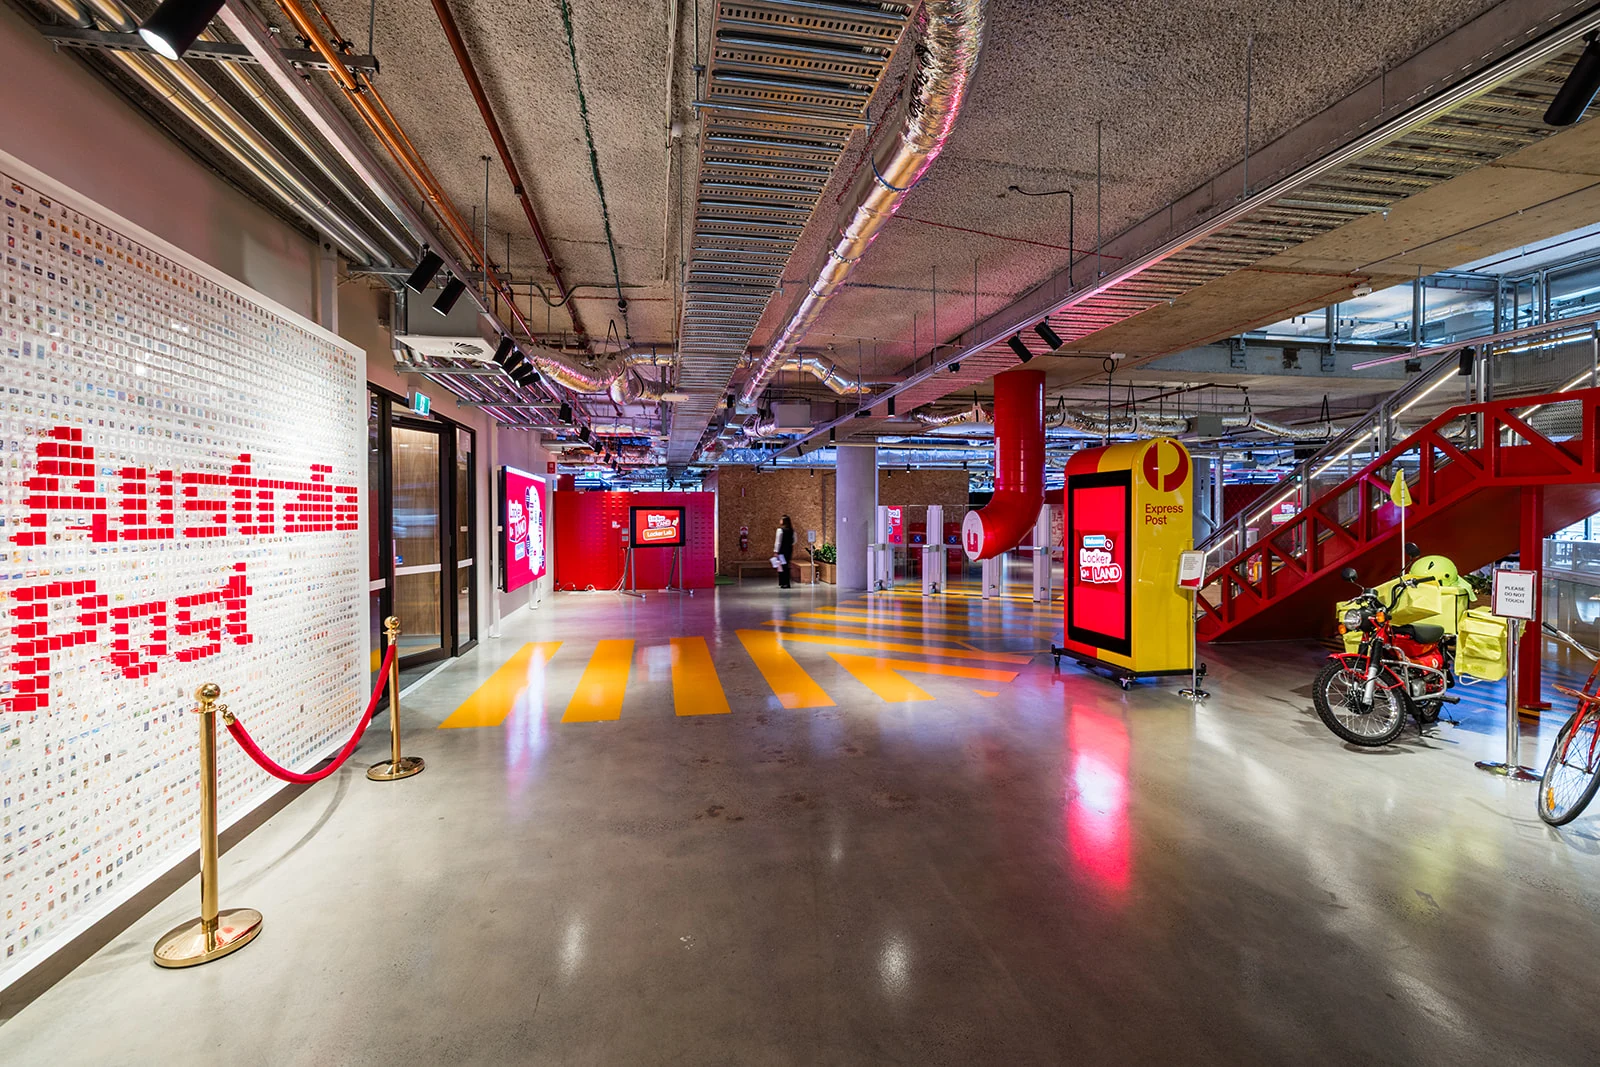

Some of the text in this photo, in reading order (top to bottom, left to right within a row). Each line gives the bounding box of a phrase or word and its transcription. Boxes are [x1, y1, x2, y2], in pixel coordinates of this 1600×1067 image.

[13, 426, 358, 546] Australia
[1145, 503, 1184, 515] Express
[1145, 515, 1168, 525] Post
[1081, 550, 1110, 565] Locker
[1094, 566, 1119, 581] LAND
[4, 562, 253, 711] Post
